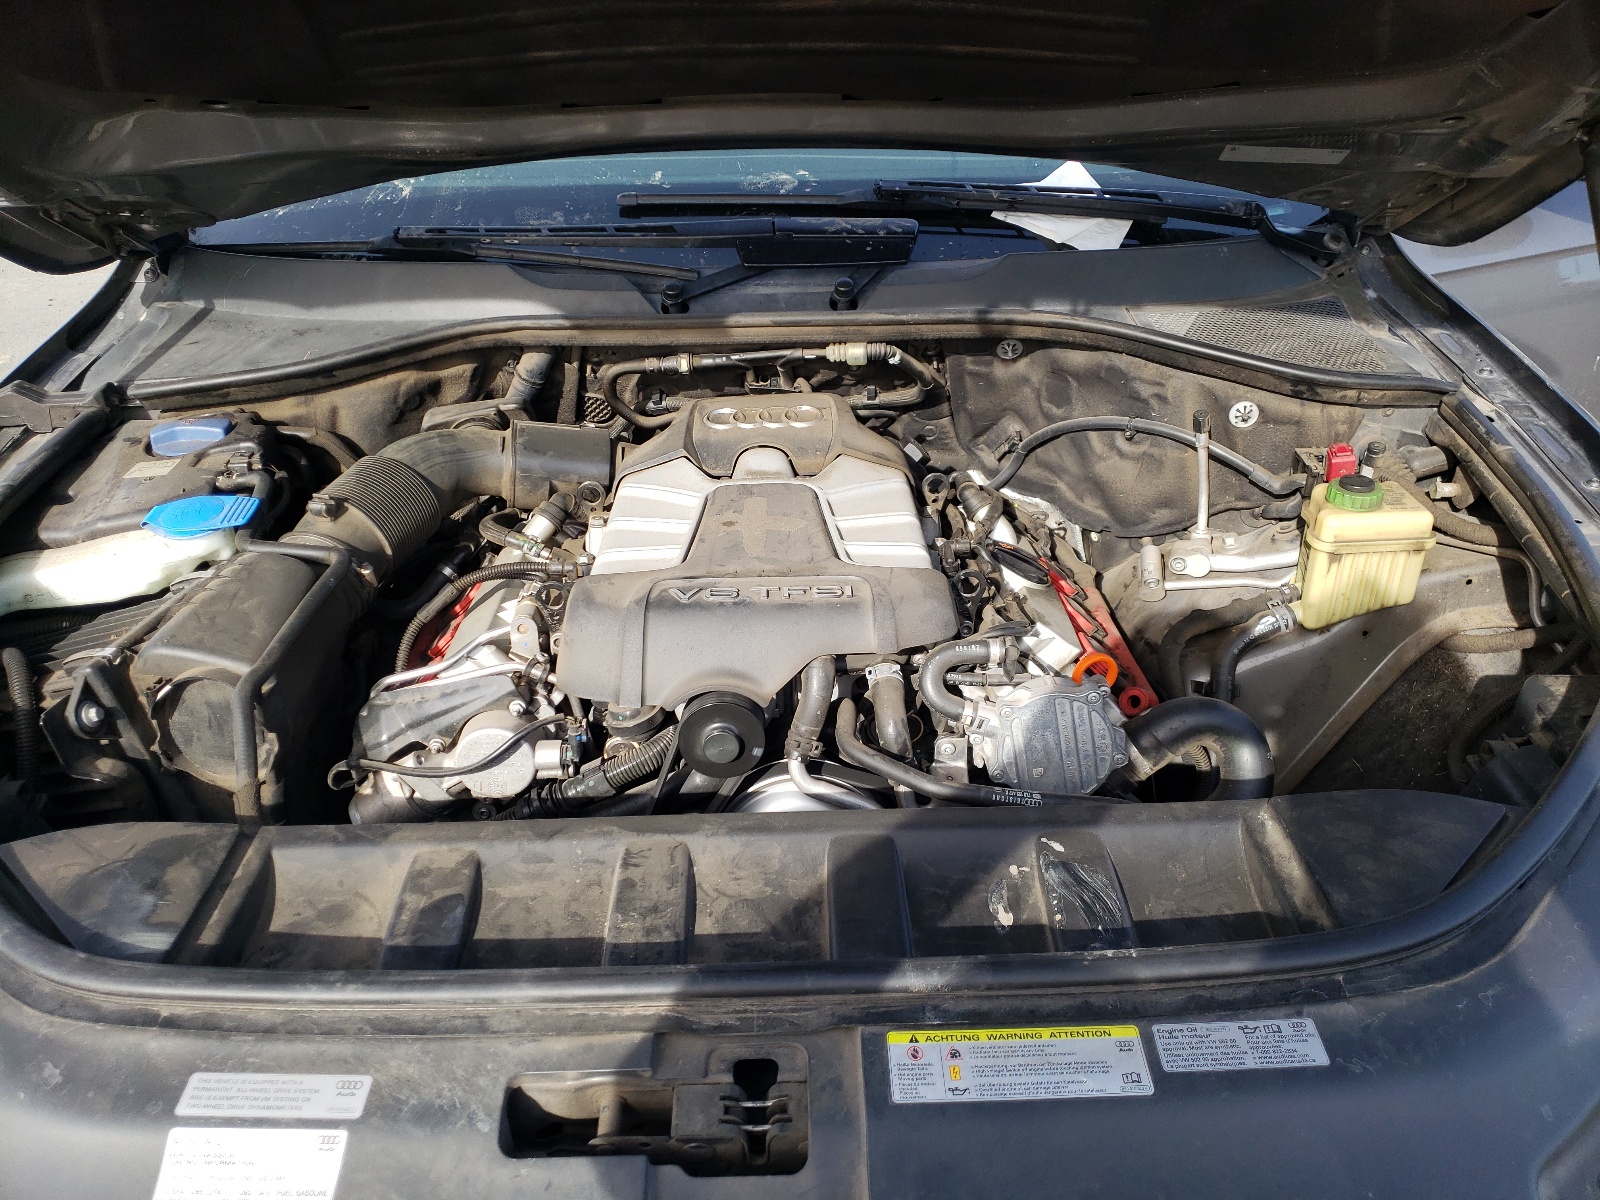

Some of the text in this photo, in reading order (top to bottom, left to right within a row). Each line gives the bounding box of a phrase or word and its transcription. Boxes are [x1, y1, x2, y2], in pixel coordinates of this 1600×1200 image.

[668, 586, 854, 602] V6 TFSI
[925, 1030, 1112, 1042] ACHTUNG WARNING ATTENTION
